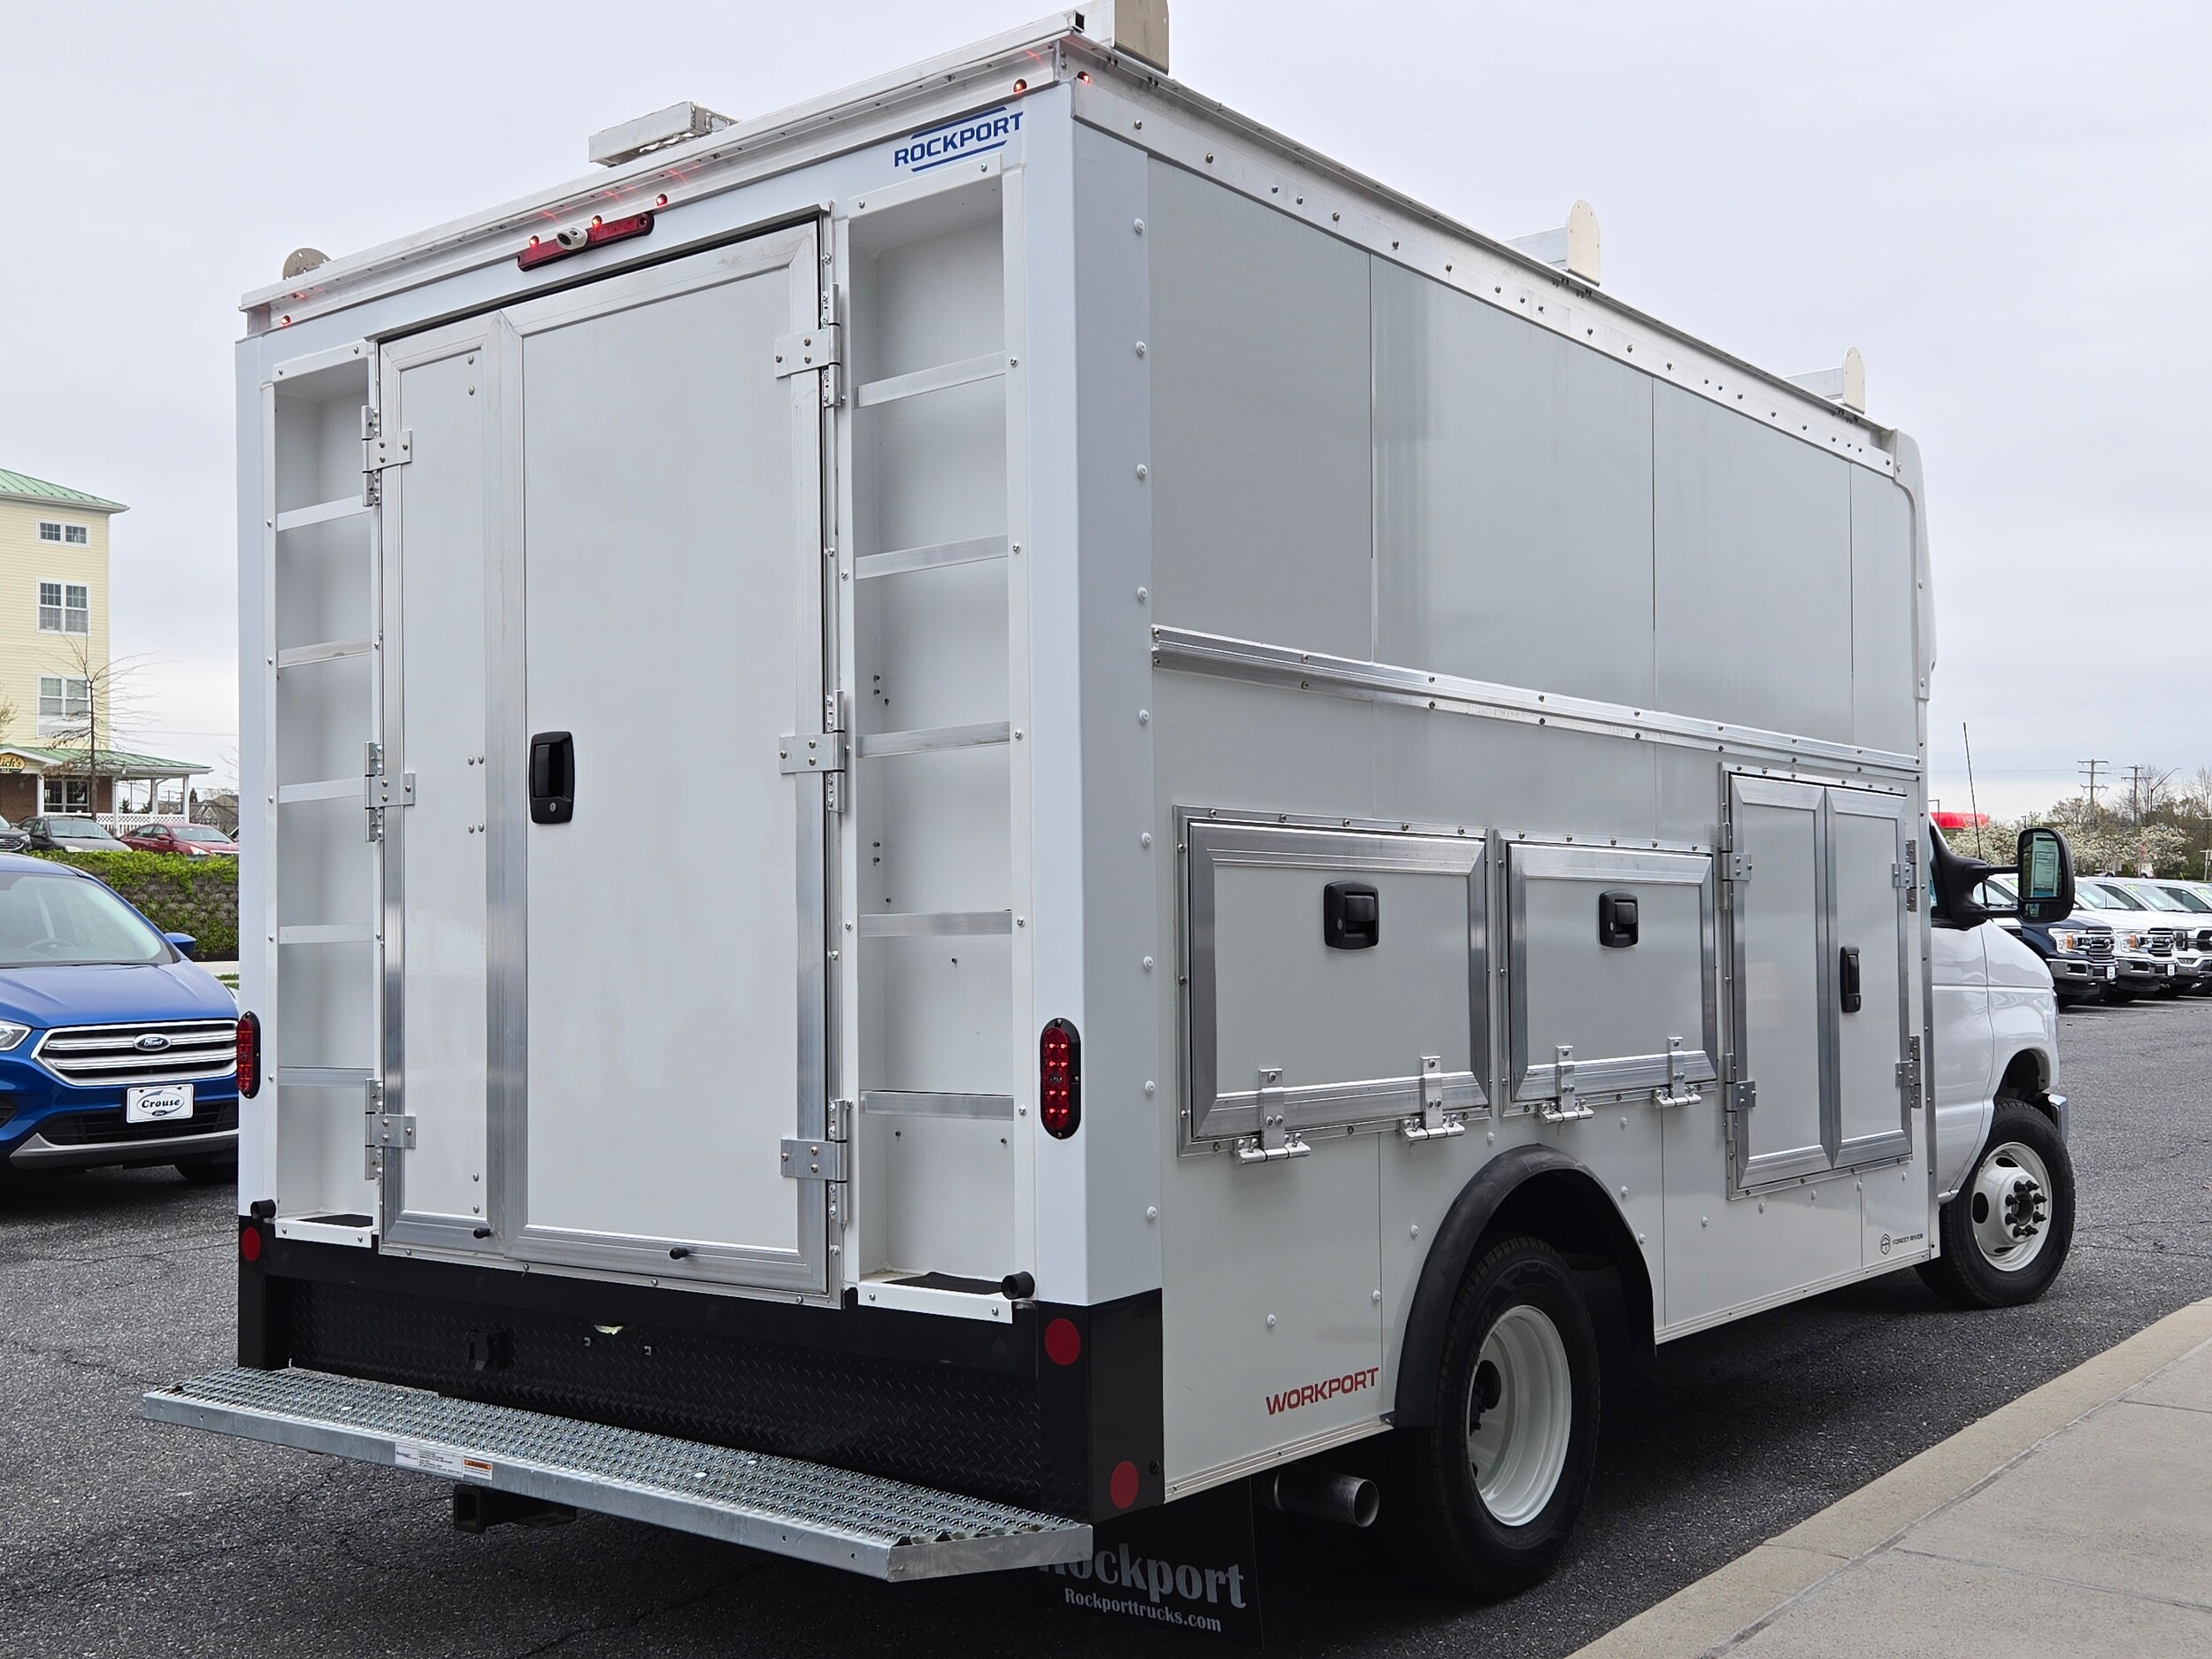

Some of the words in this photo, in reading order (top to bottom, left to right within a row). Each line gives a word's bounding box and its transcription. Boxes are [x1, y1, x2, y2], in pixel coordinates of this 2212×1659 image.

[894, 111, 1024, 167] ROCKPORT
[143, 1037, 164, 1047] Ford
[141, 1098, 180, 1109] Crouse
[1265, 1367, 1379, 1416] WORKPORT
[1038, 1542, 1247, 1609] ockport
[1064, 1587, 1222, 1632] Rockporttrucks.com
